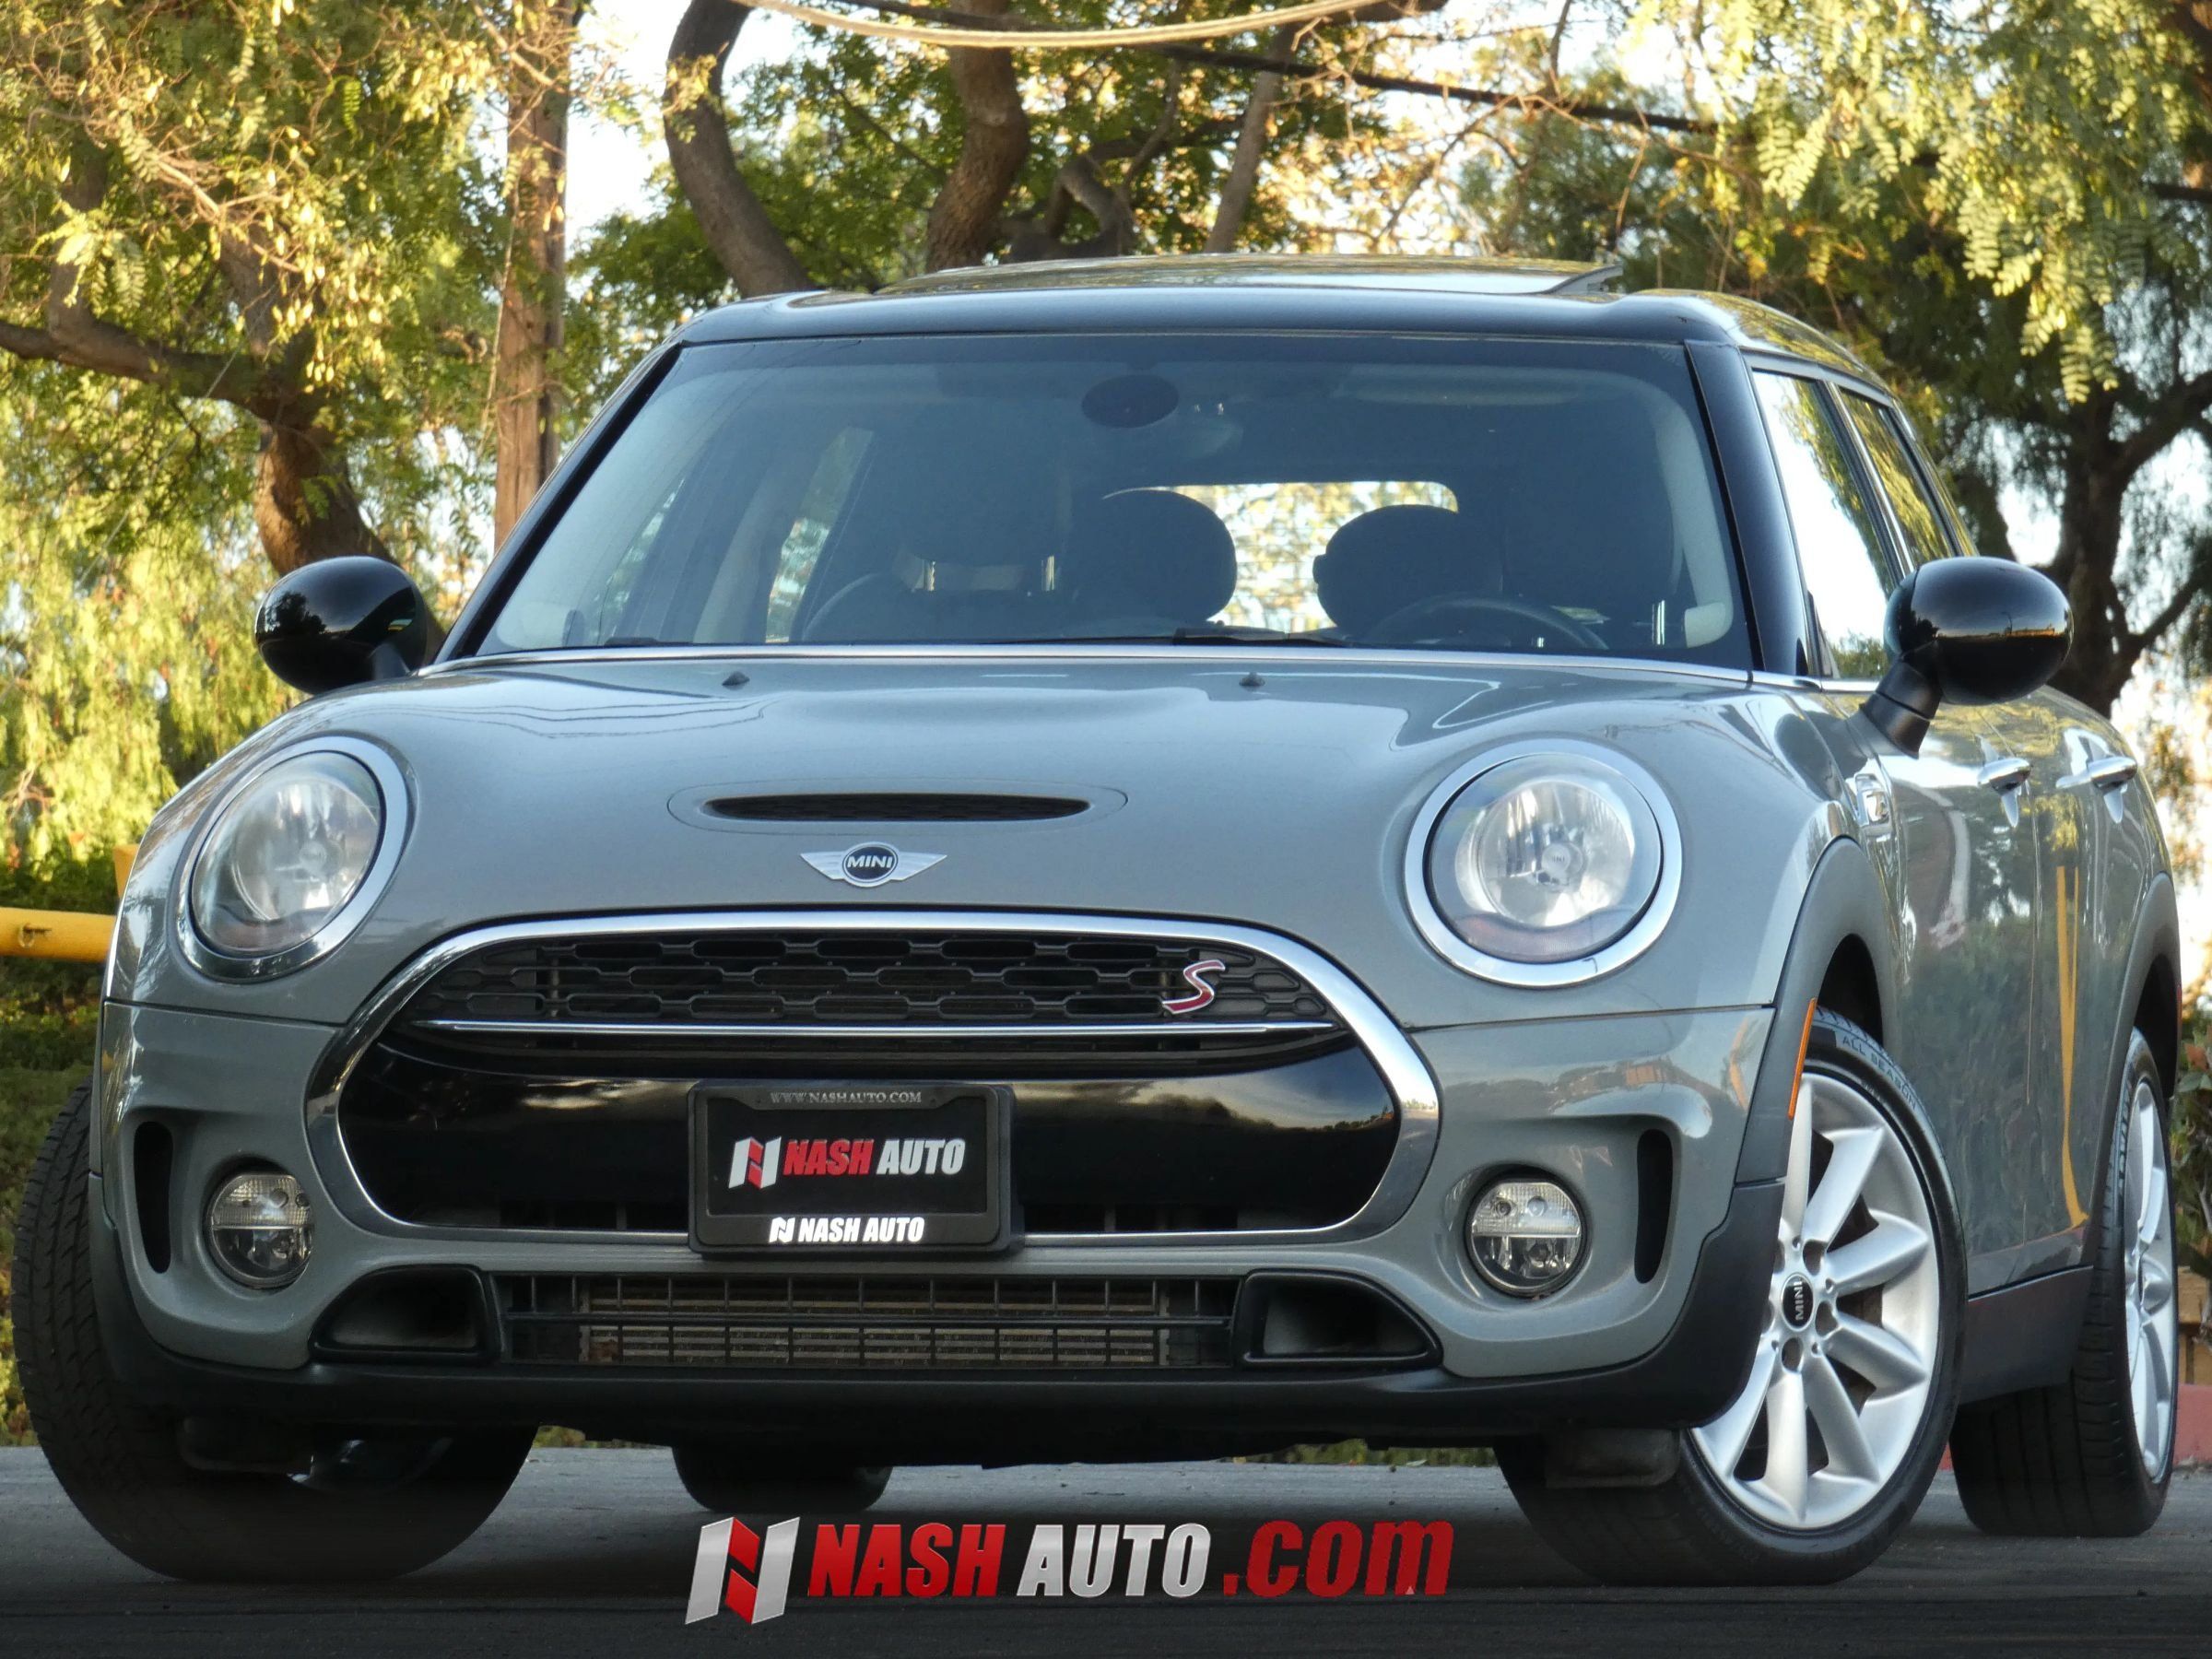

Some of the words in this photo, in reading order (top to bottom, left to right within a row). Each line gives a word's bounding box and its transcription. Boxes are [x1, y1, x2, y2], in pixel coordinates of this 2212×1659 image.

[846, 854, 893, 868] MINI
[1162, 959, 1226, 1015] S
[1842, 1035, 1866, 1056] ALL
[770, 1091, 922, 1104] WWW.NASHAUTO.COM
[783, 1138, 875, 1175] NASH
[876, 1138, 966, 1175] AUTO
[798, 1218, 859, 1242] NASH
[863, 1217, 925, 1242] AUTO
[1793, 1280, 1804, 1321] MINI
